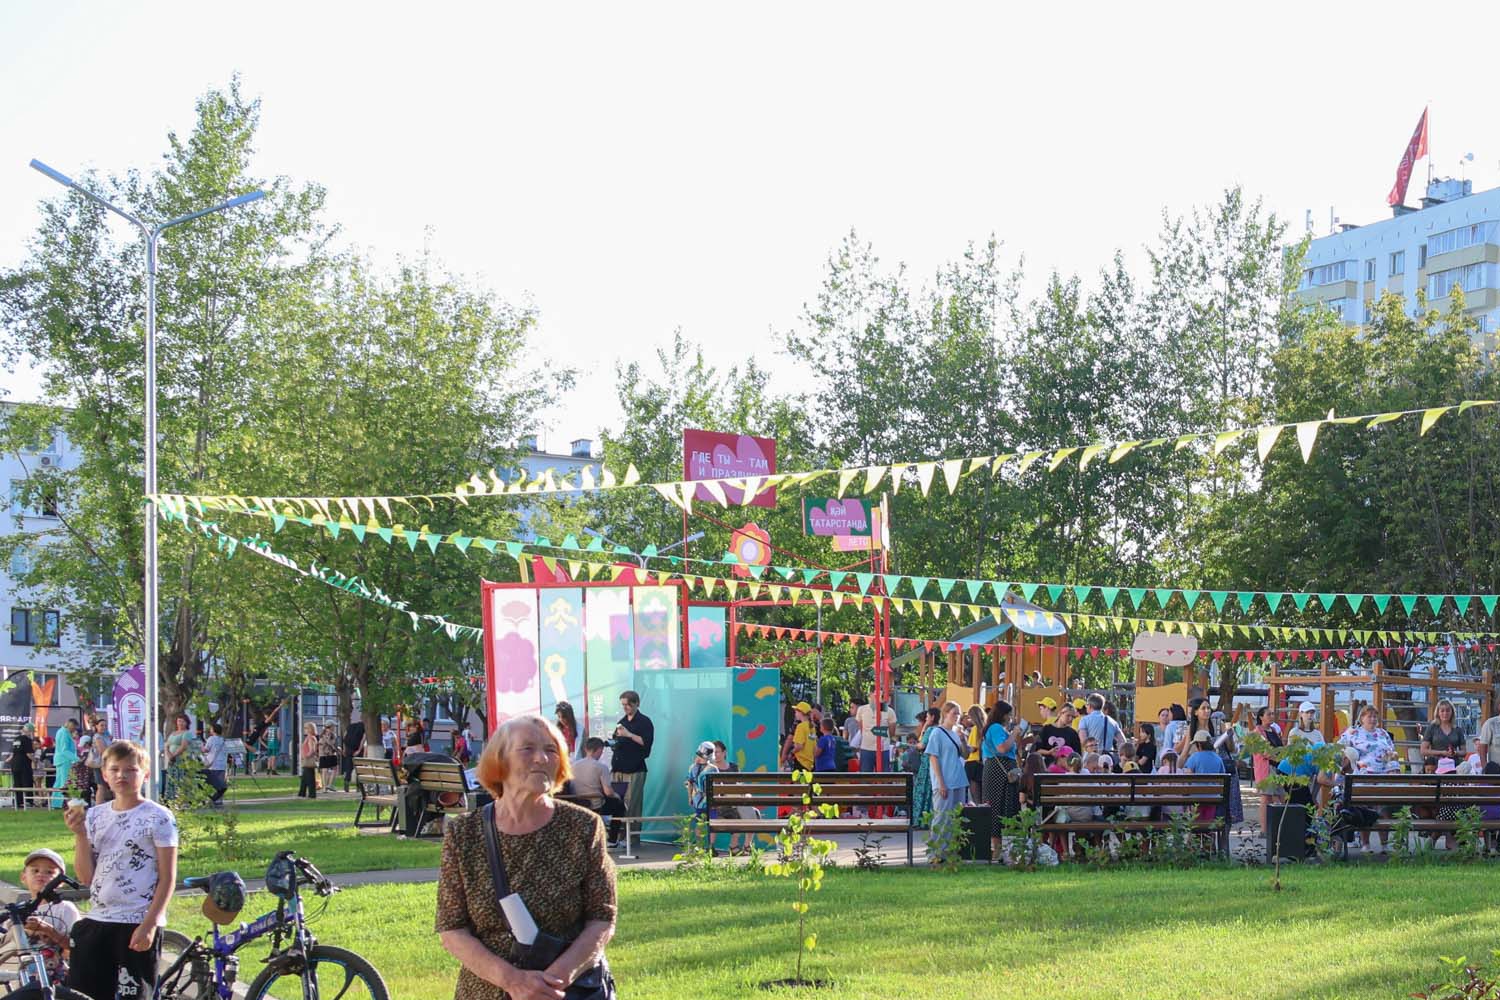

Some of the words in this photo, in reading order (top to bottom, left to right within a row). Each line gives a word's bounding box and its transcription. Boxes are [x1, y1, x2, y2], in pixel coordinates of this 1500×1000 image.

[692, 451, 711, 464] ГДЕ
[717, 454, 731, 465] ТЫ
[748, 458, 768, 469] ТАМ
[698, 466, 705, 477] И
[809, 519, 868, 529] ТАТАРСТАНДА
[125, 839, 153, 861] GREAT
[129, 857, 146, 871] DAY
